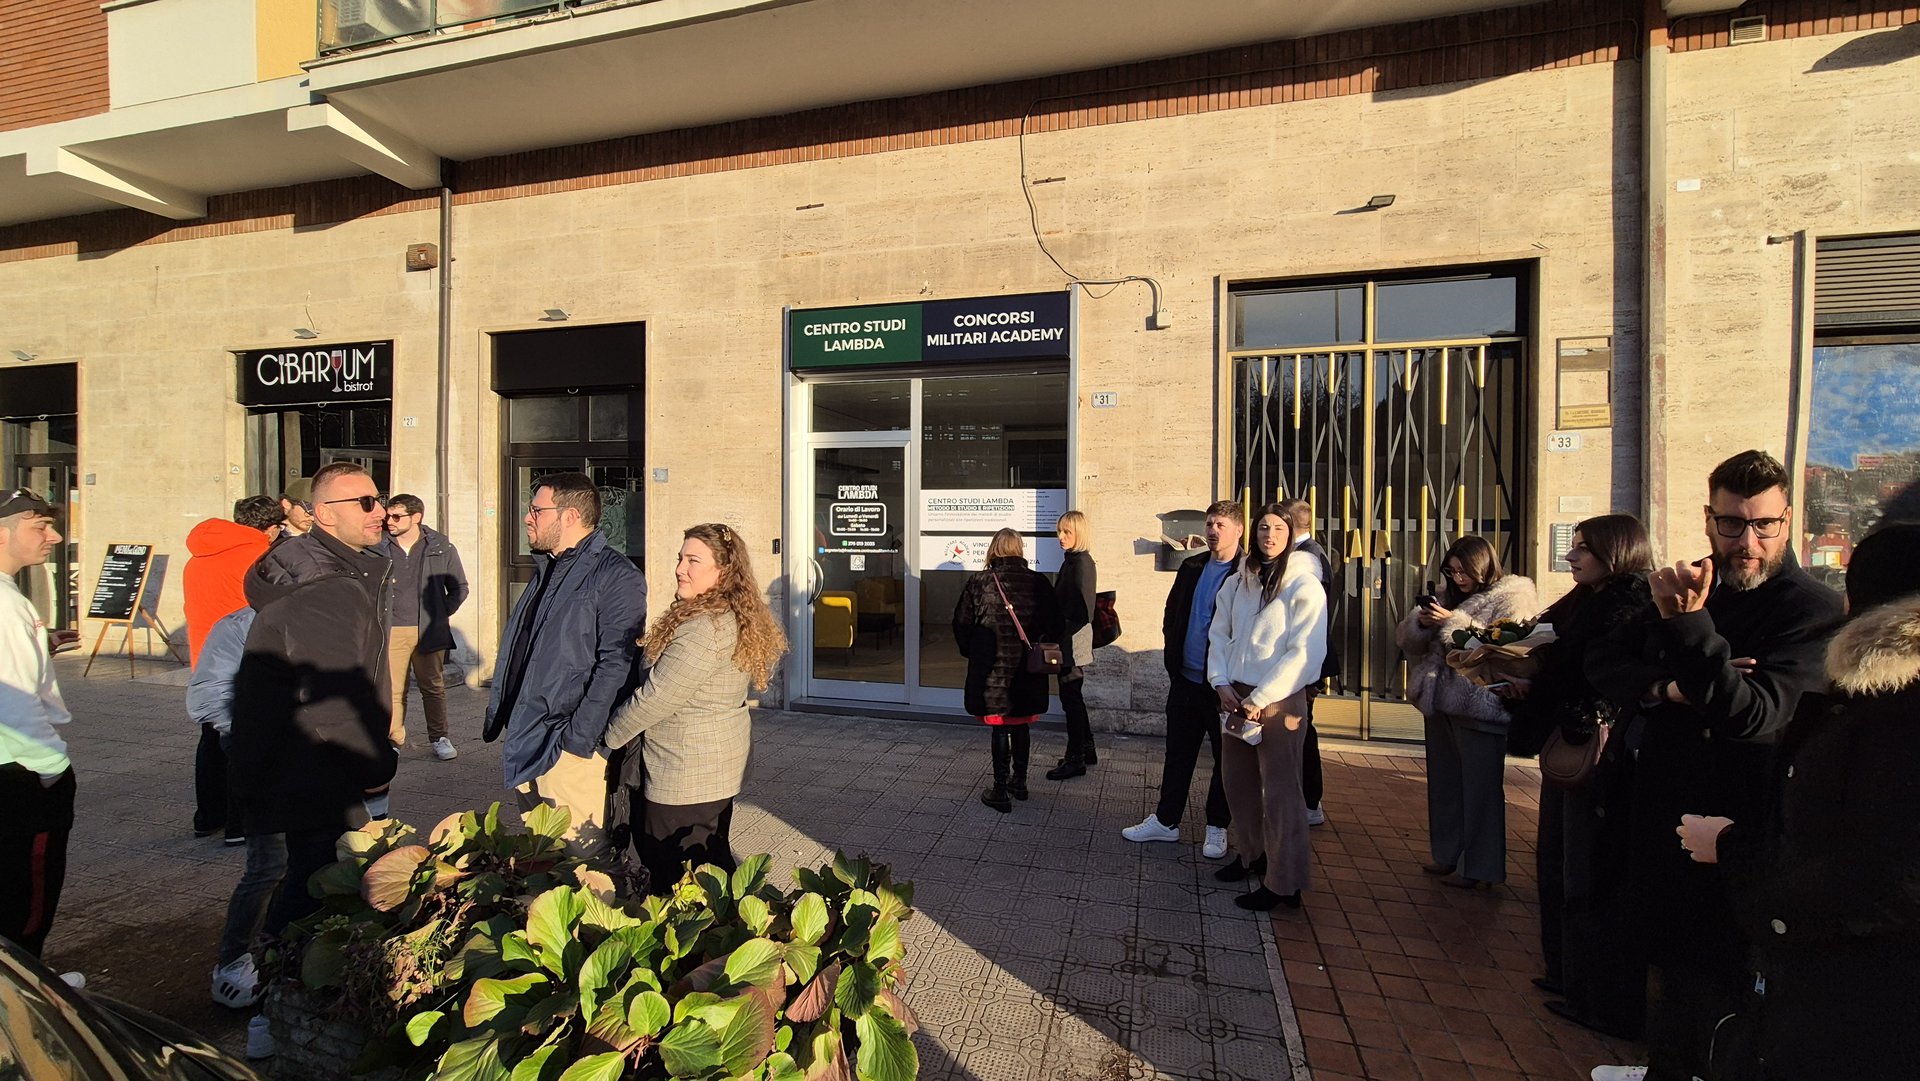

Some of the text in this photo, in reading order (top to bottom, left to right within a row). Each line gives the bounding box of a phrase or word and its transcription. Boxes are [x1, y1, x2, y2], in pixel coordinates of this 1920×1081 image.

[953, 311, 1035, 328] CONCORSI
[803, 318, 906, 337] CENTRO STUDI
[926, 327, 1064, 347] MILITARI ACADEMY
[824, 337, 885, 352] LAMBDA
[343, 380, 374, 392] bistrot
[1099, 394, 1109, 405] 31
[1557, 437, 1571, 448] 33
[838, 491, 878, 499] LAMBDA
